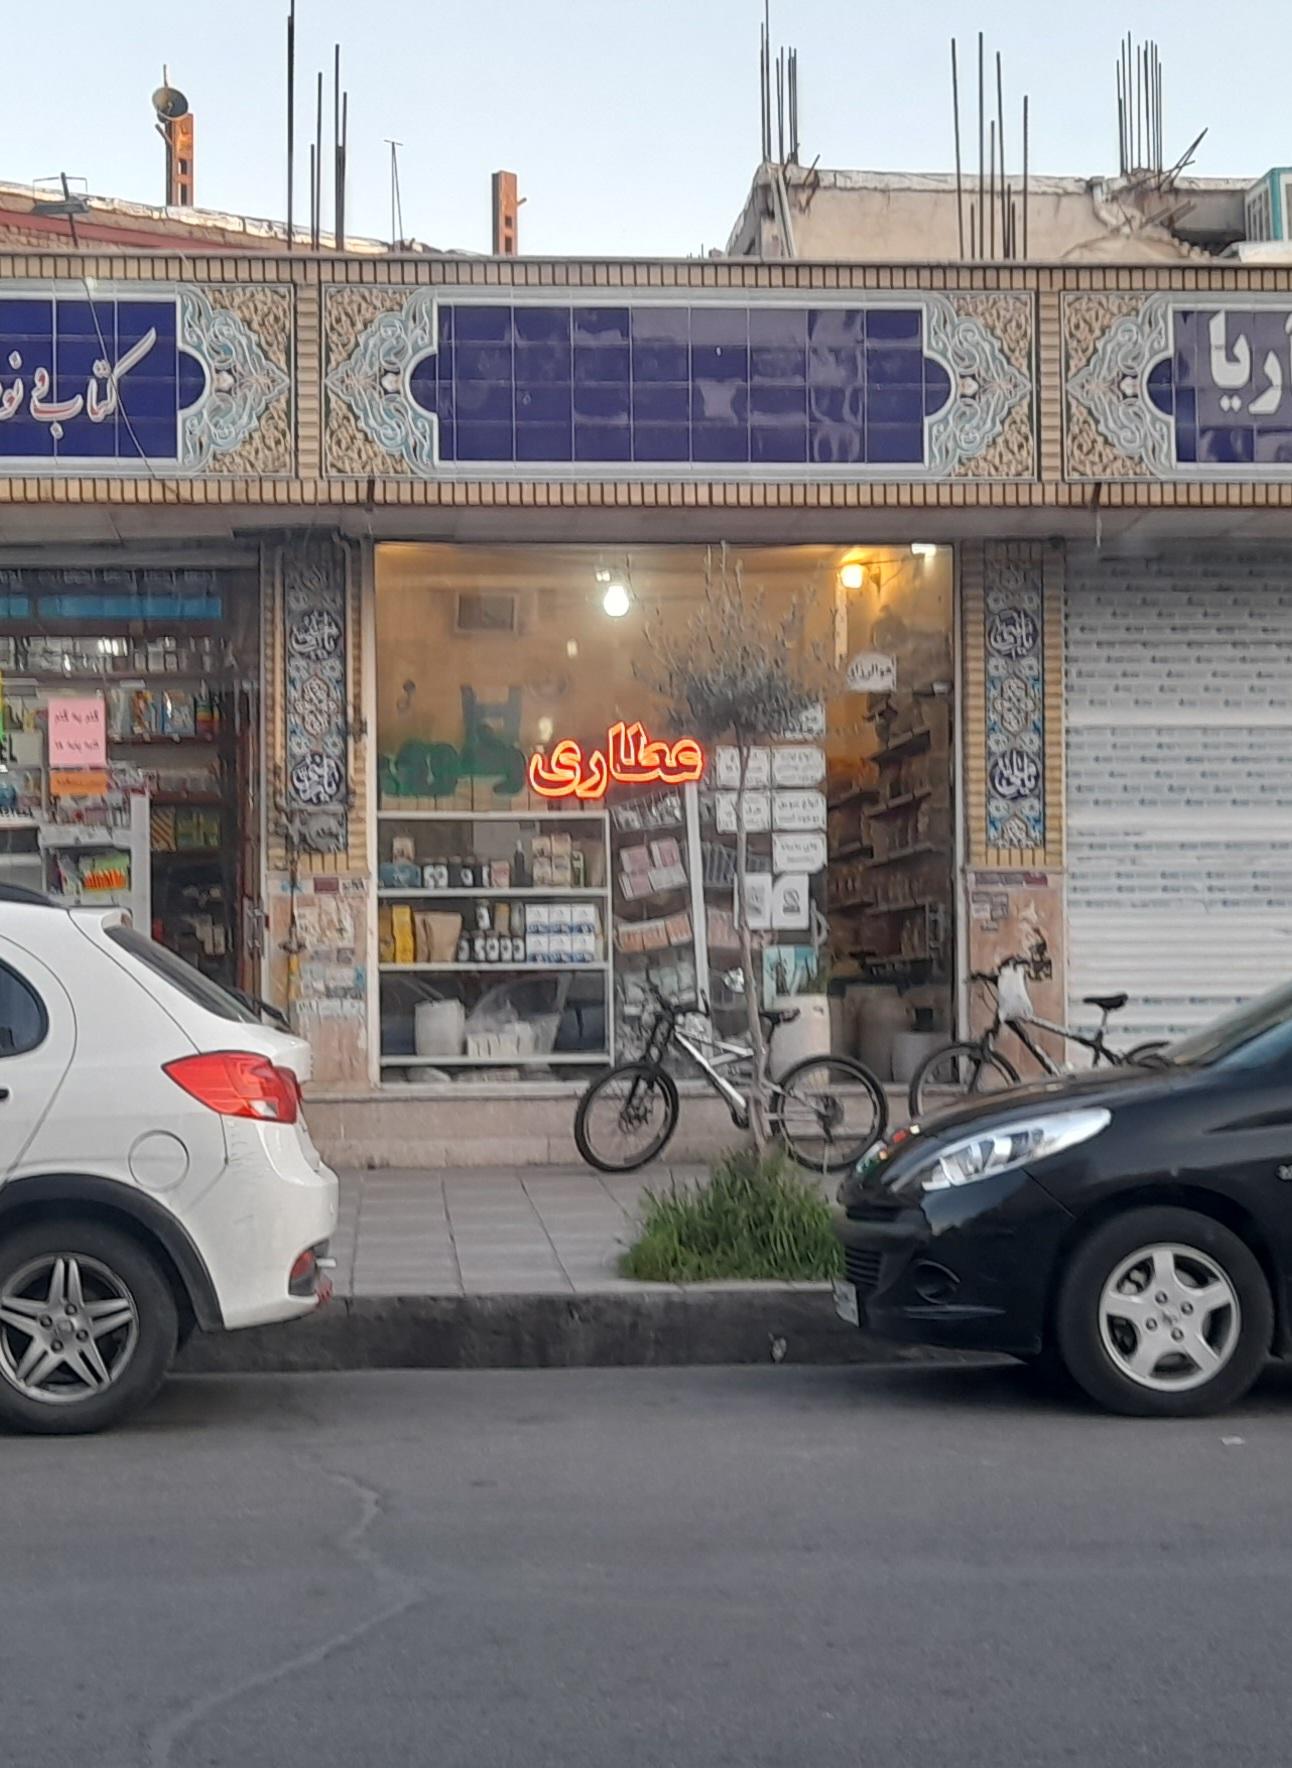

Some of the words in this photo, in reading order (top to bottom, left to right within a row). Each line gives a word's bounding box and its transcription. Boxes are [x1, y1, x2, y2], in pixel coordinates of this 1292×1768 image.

[0, 350, 24, 421] نو
[1208, 309, 1292, 415] ریا
[528, 721, 705, 799] عطاری
